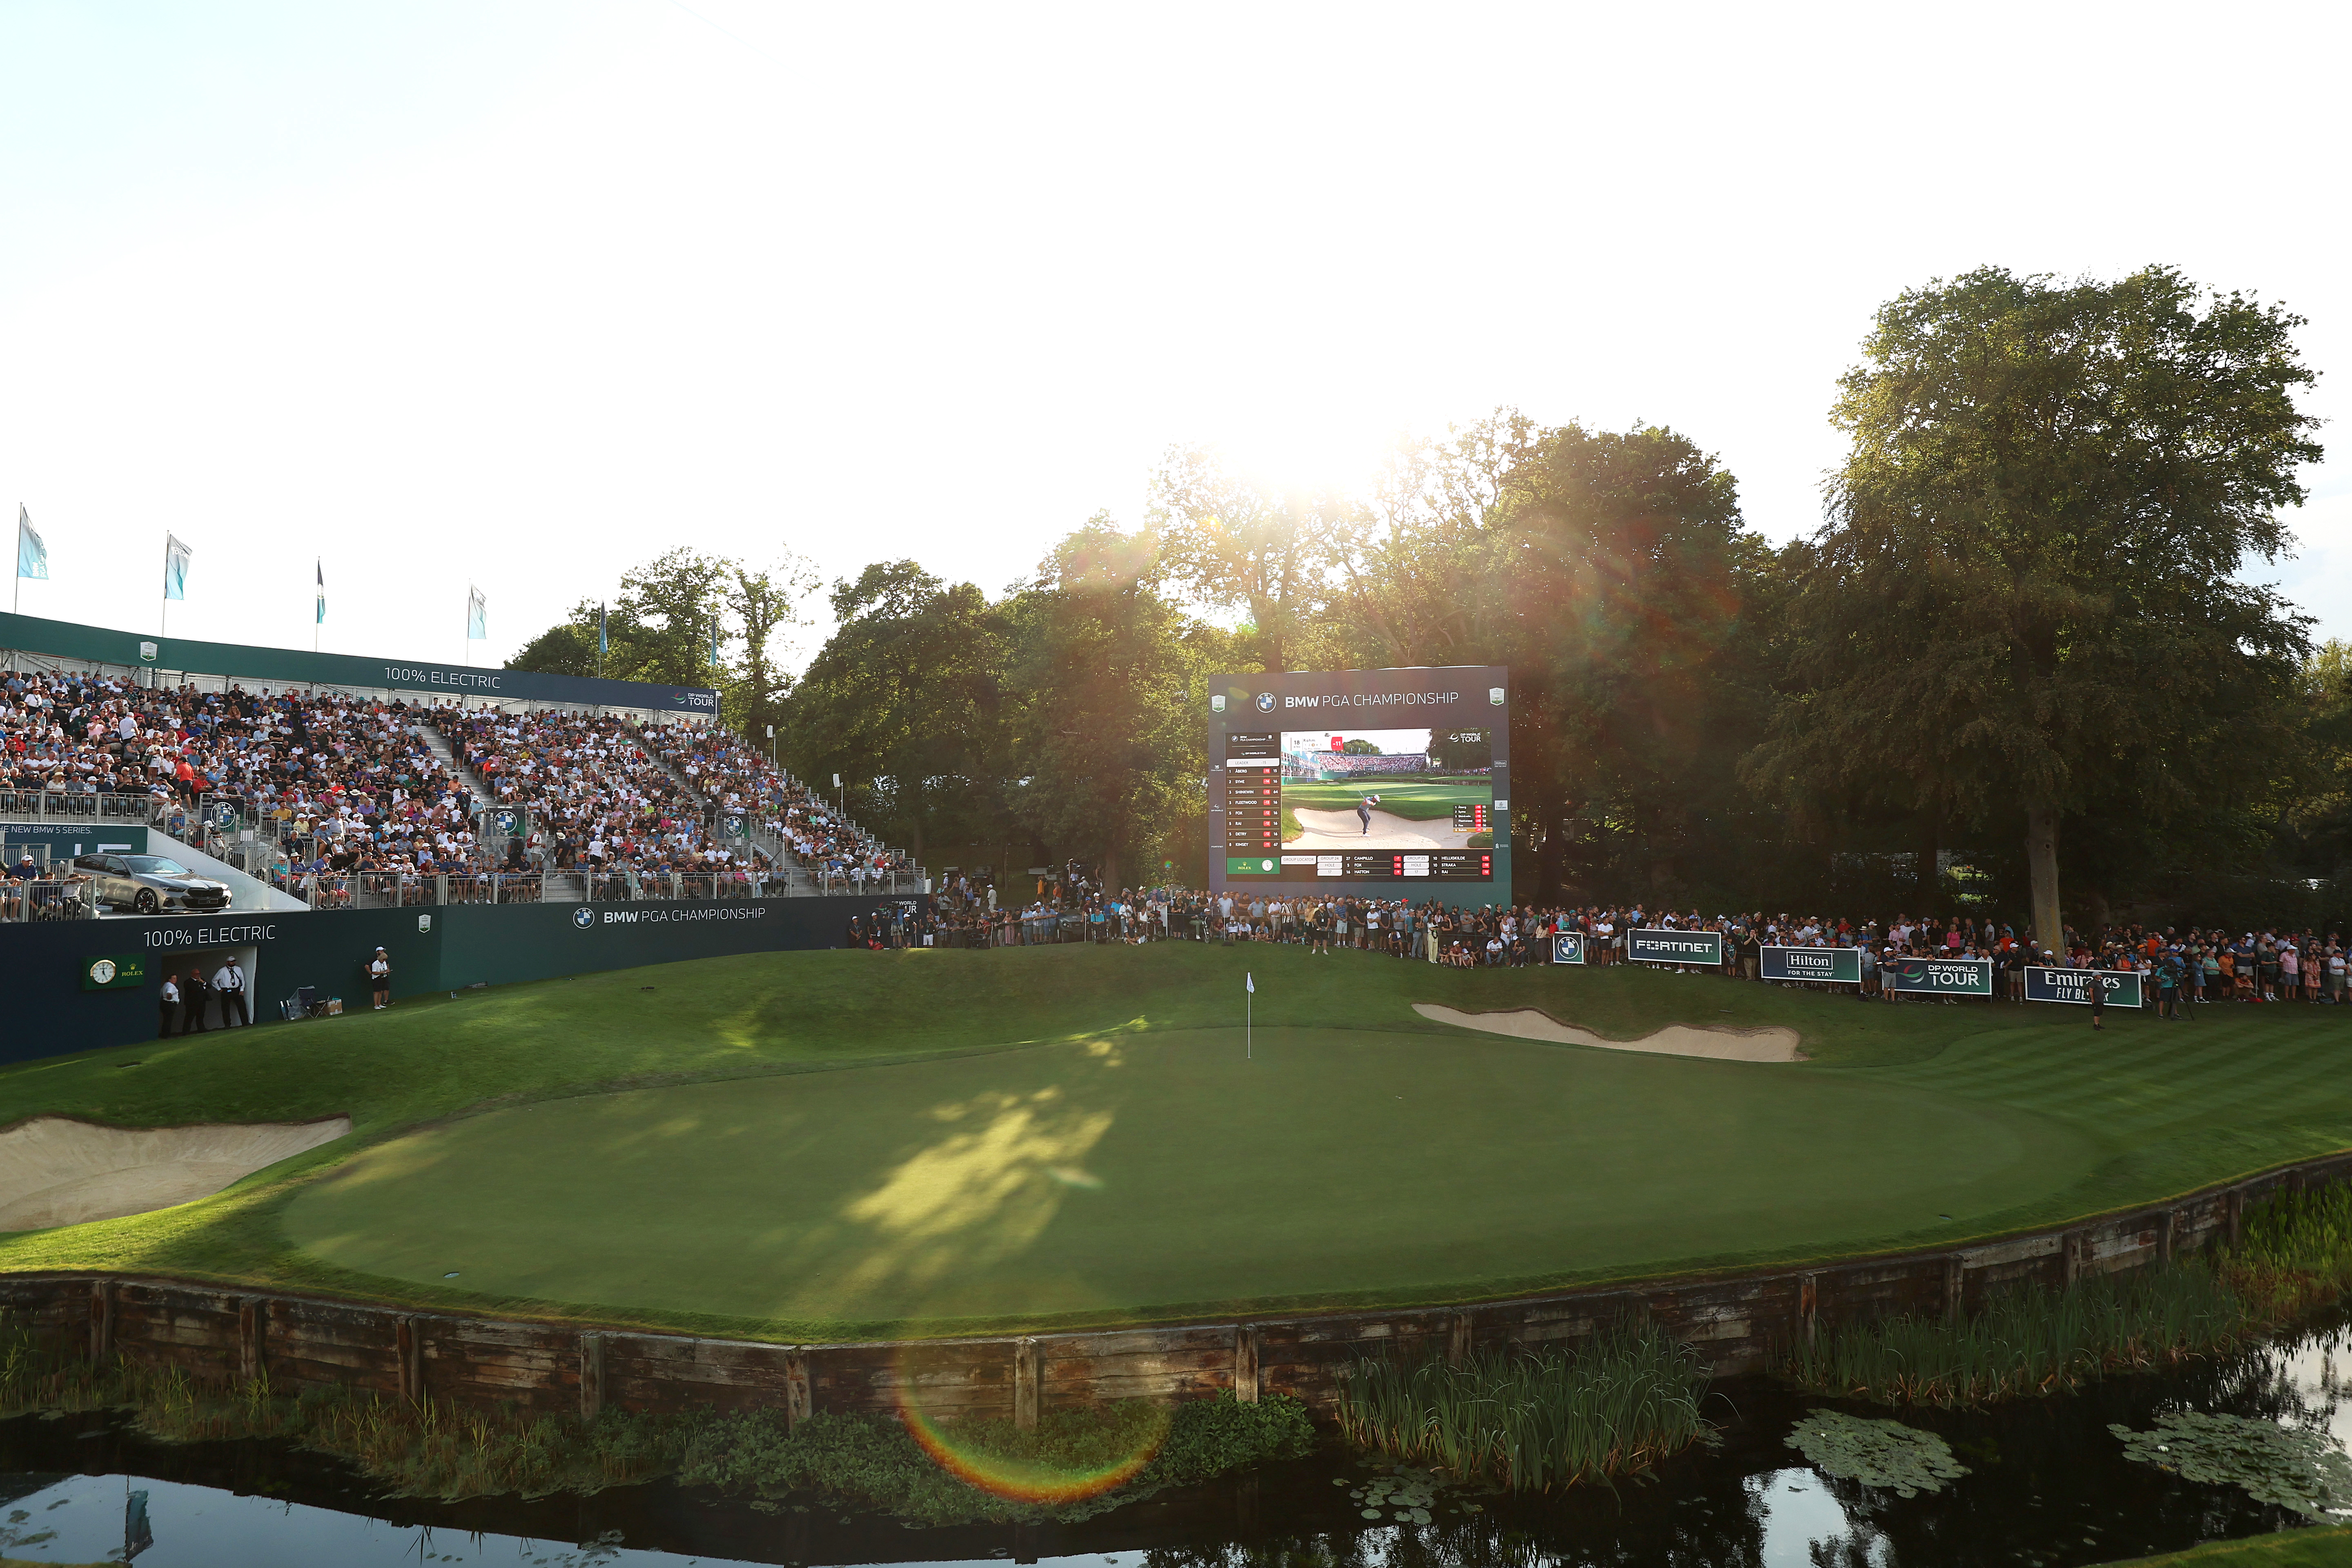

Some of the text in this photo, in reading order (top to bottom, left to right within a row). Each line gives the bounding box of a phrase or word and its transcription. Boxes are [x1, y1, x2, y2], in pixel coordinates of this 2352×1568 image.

[384, 667, 501, 688] 100% ELECTRIC
[688, 697, 714, 707] TOUR
[1285, 692, 1459, 707] BMW PGA CHAMPIONSHIP
[604, 908, 765, 923] BMW PGA CHAMPIONSHIP
[143, 925, 276, 947] 100% ELECTRIC
[1636, 940, 1712, 953] FORTINET
[1790, 955, 1829, 966] Hilton
[1928, 972, 1980, 987] TOUR
[2056, 987, 2072, 999] FLY
